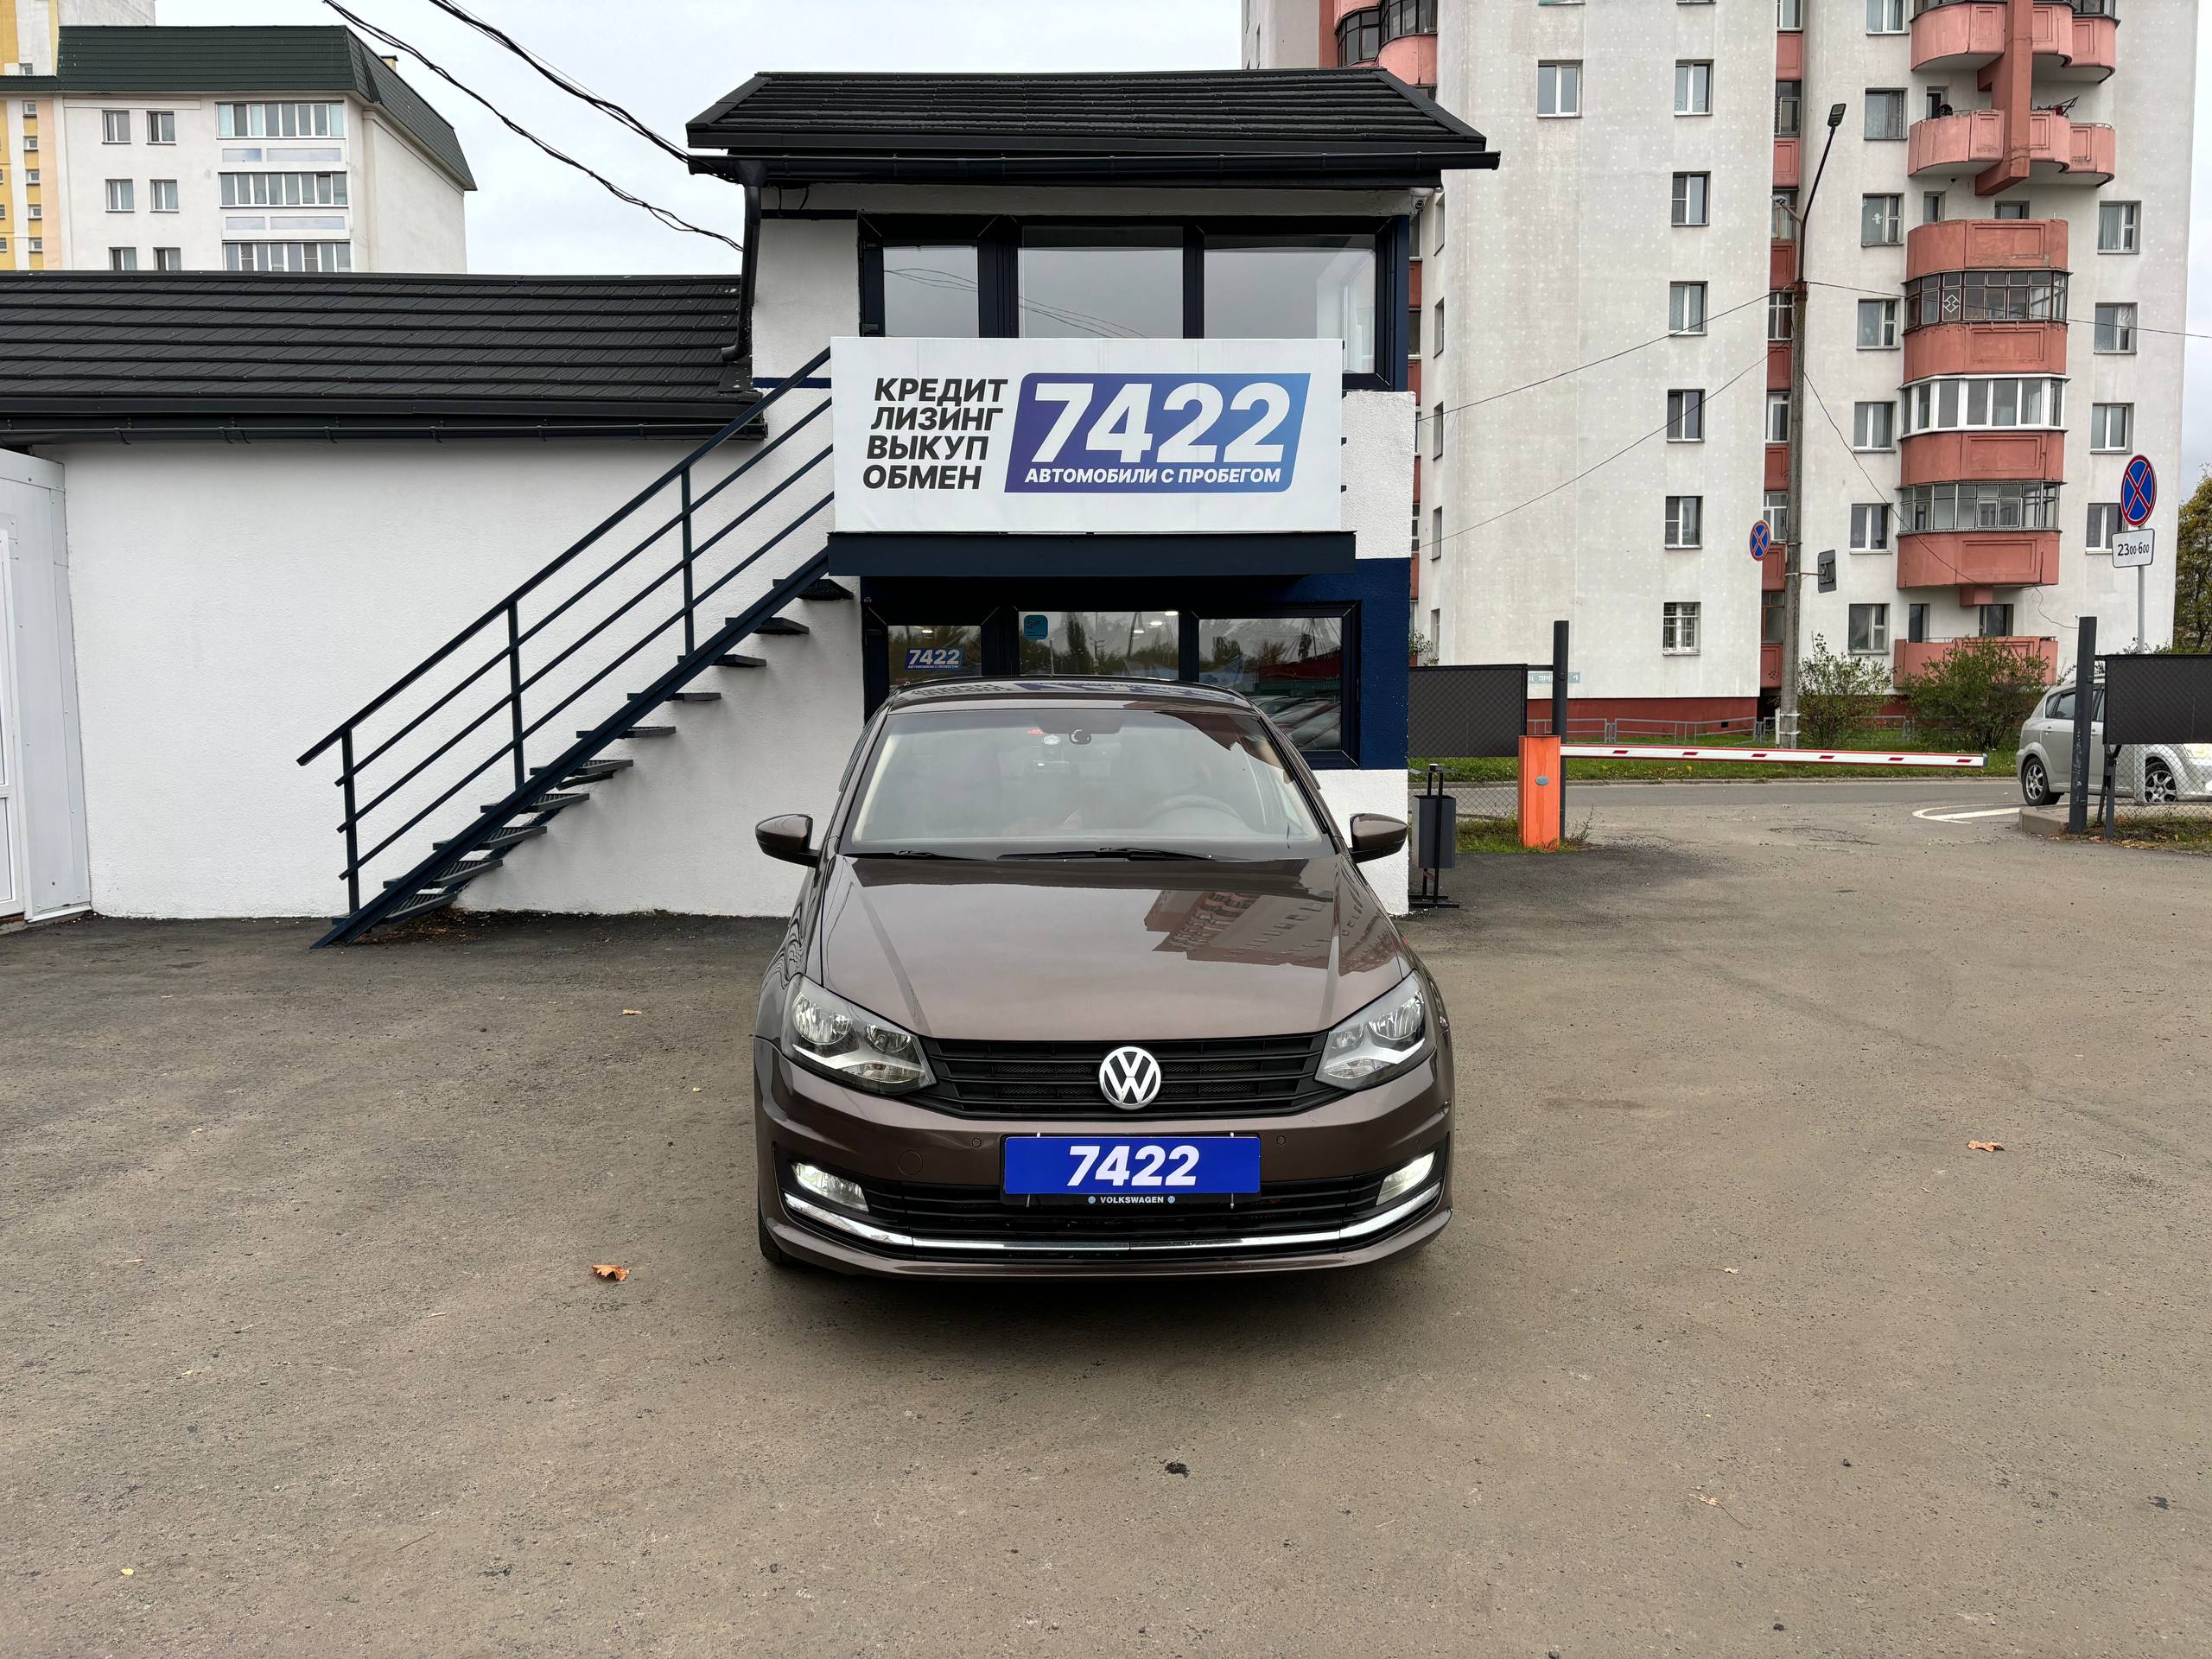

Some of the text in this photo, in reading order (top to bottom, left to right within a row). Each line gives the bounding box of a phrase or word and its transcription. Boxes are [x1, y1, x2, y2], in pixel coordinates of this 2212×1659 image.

[874, 378, 1008, 407] КРЕДИТ
[870, 407, 1004, 430] ЛИЗИНГ
[1032, 382, 1290, 463] 7422
[867, 435, 989, 460] ВЫКУП
[863, 465, 982, 490] ОБМЕН
[1025, 468, 1281, 483] АВТОМОБИЛИ С ПРОБЕГОМ
[909, 649, 960, 664] 7422
[1067, 1145, 1199, 1186] 7422
